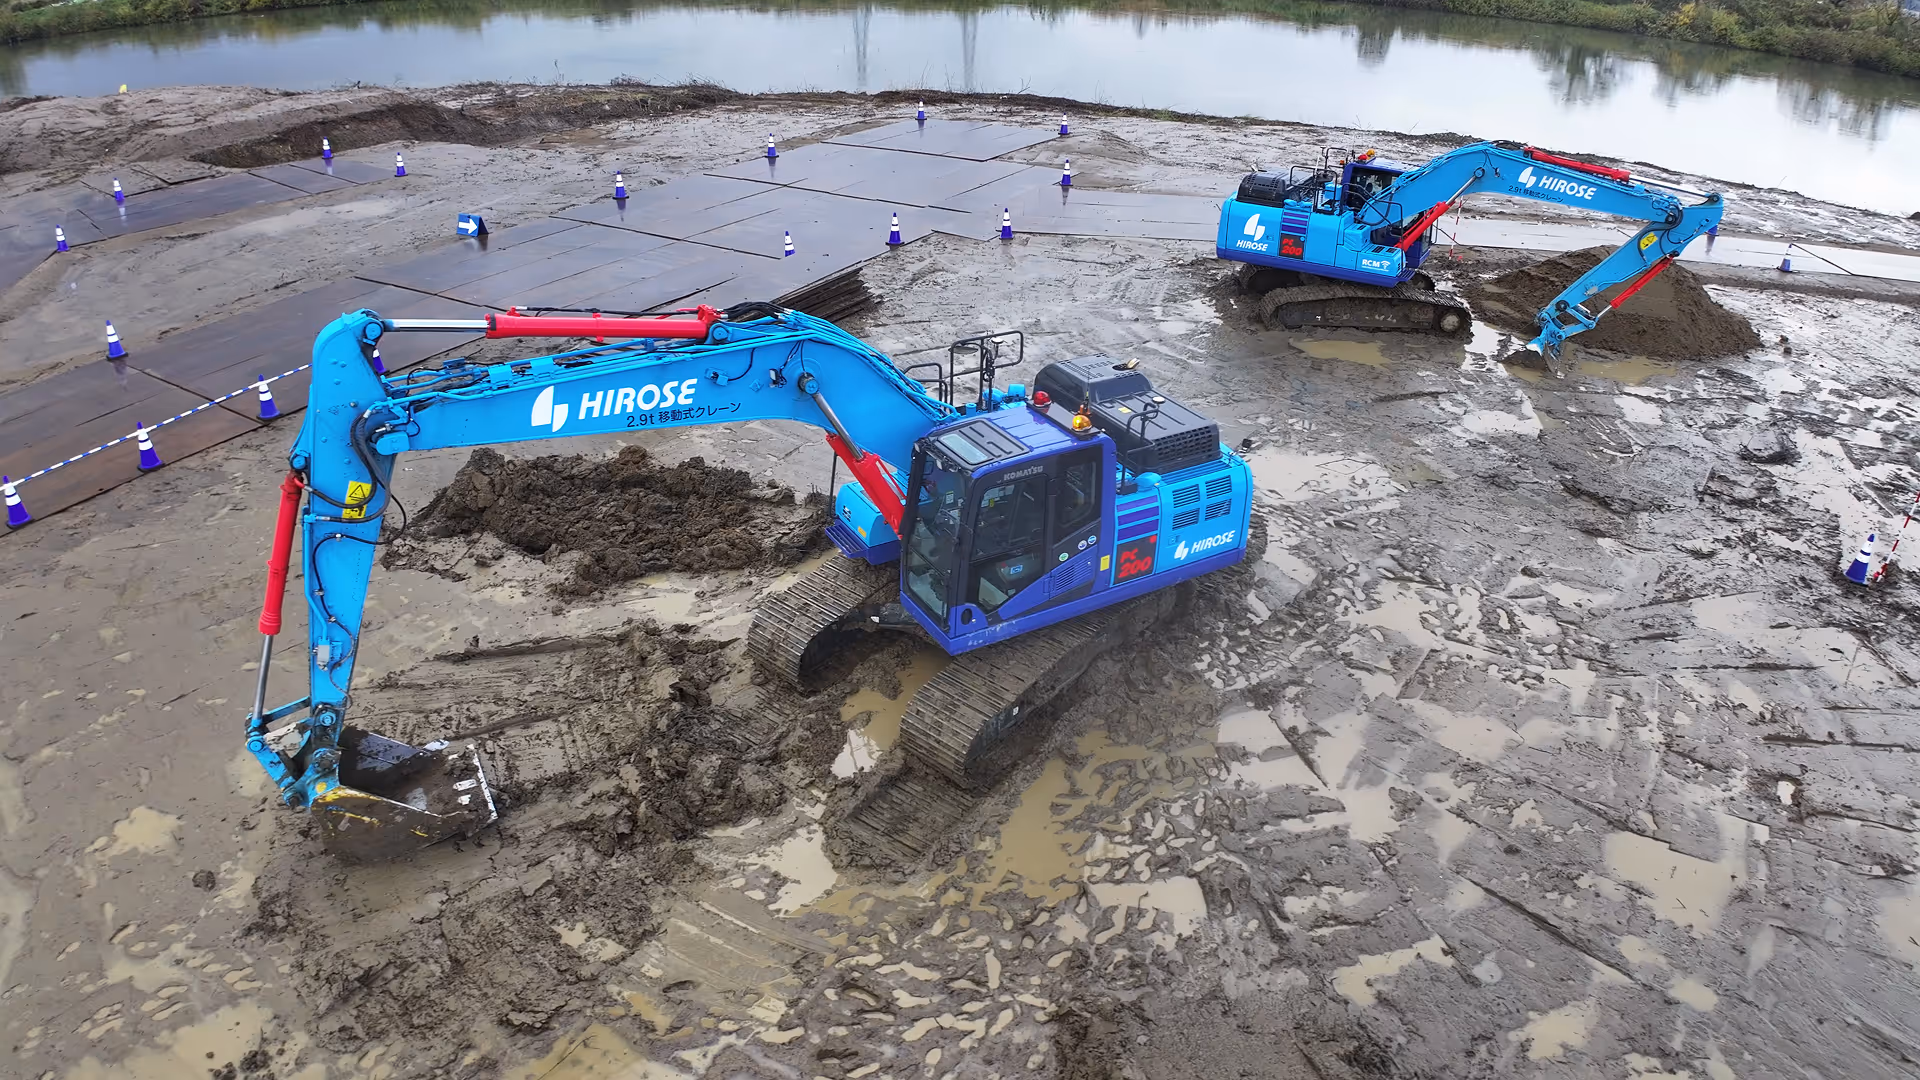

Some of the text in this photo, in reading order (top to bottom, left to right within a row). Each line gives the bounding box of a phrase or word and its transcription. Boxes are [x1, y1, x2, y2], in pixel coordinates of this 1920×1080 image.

[1538, 175, 1598, 200] HIROSE
[1522, 188, 1564, 203] 移動式クレーン
[1236, 239, 1268, 251] HIROSE
[1282, 238, 1294, 246] PC
[1281, 245, 1303, 256] 200
[1362, 259, 1380, 268] RCM
[578, 378, 698, 420] HIROSE
[658, 402, 742, 424] 移動式クレーン
[1003, 465, 1044, 481] KOMATSU
[1191, 530, 1236, 554] HIROSE
[1120, 548, 1138, 563] PC
[1118, 556, 1153, 578] 200
